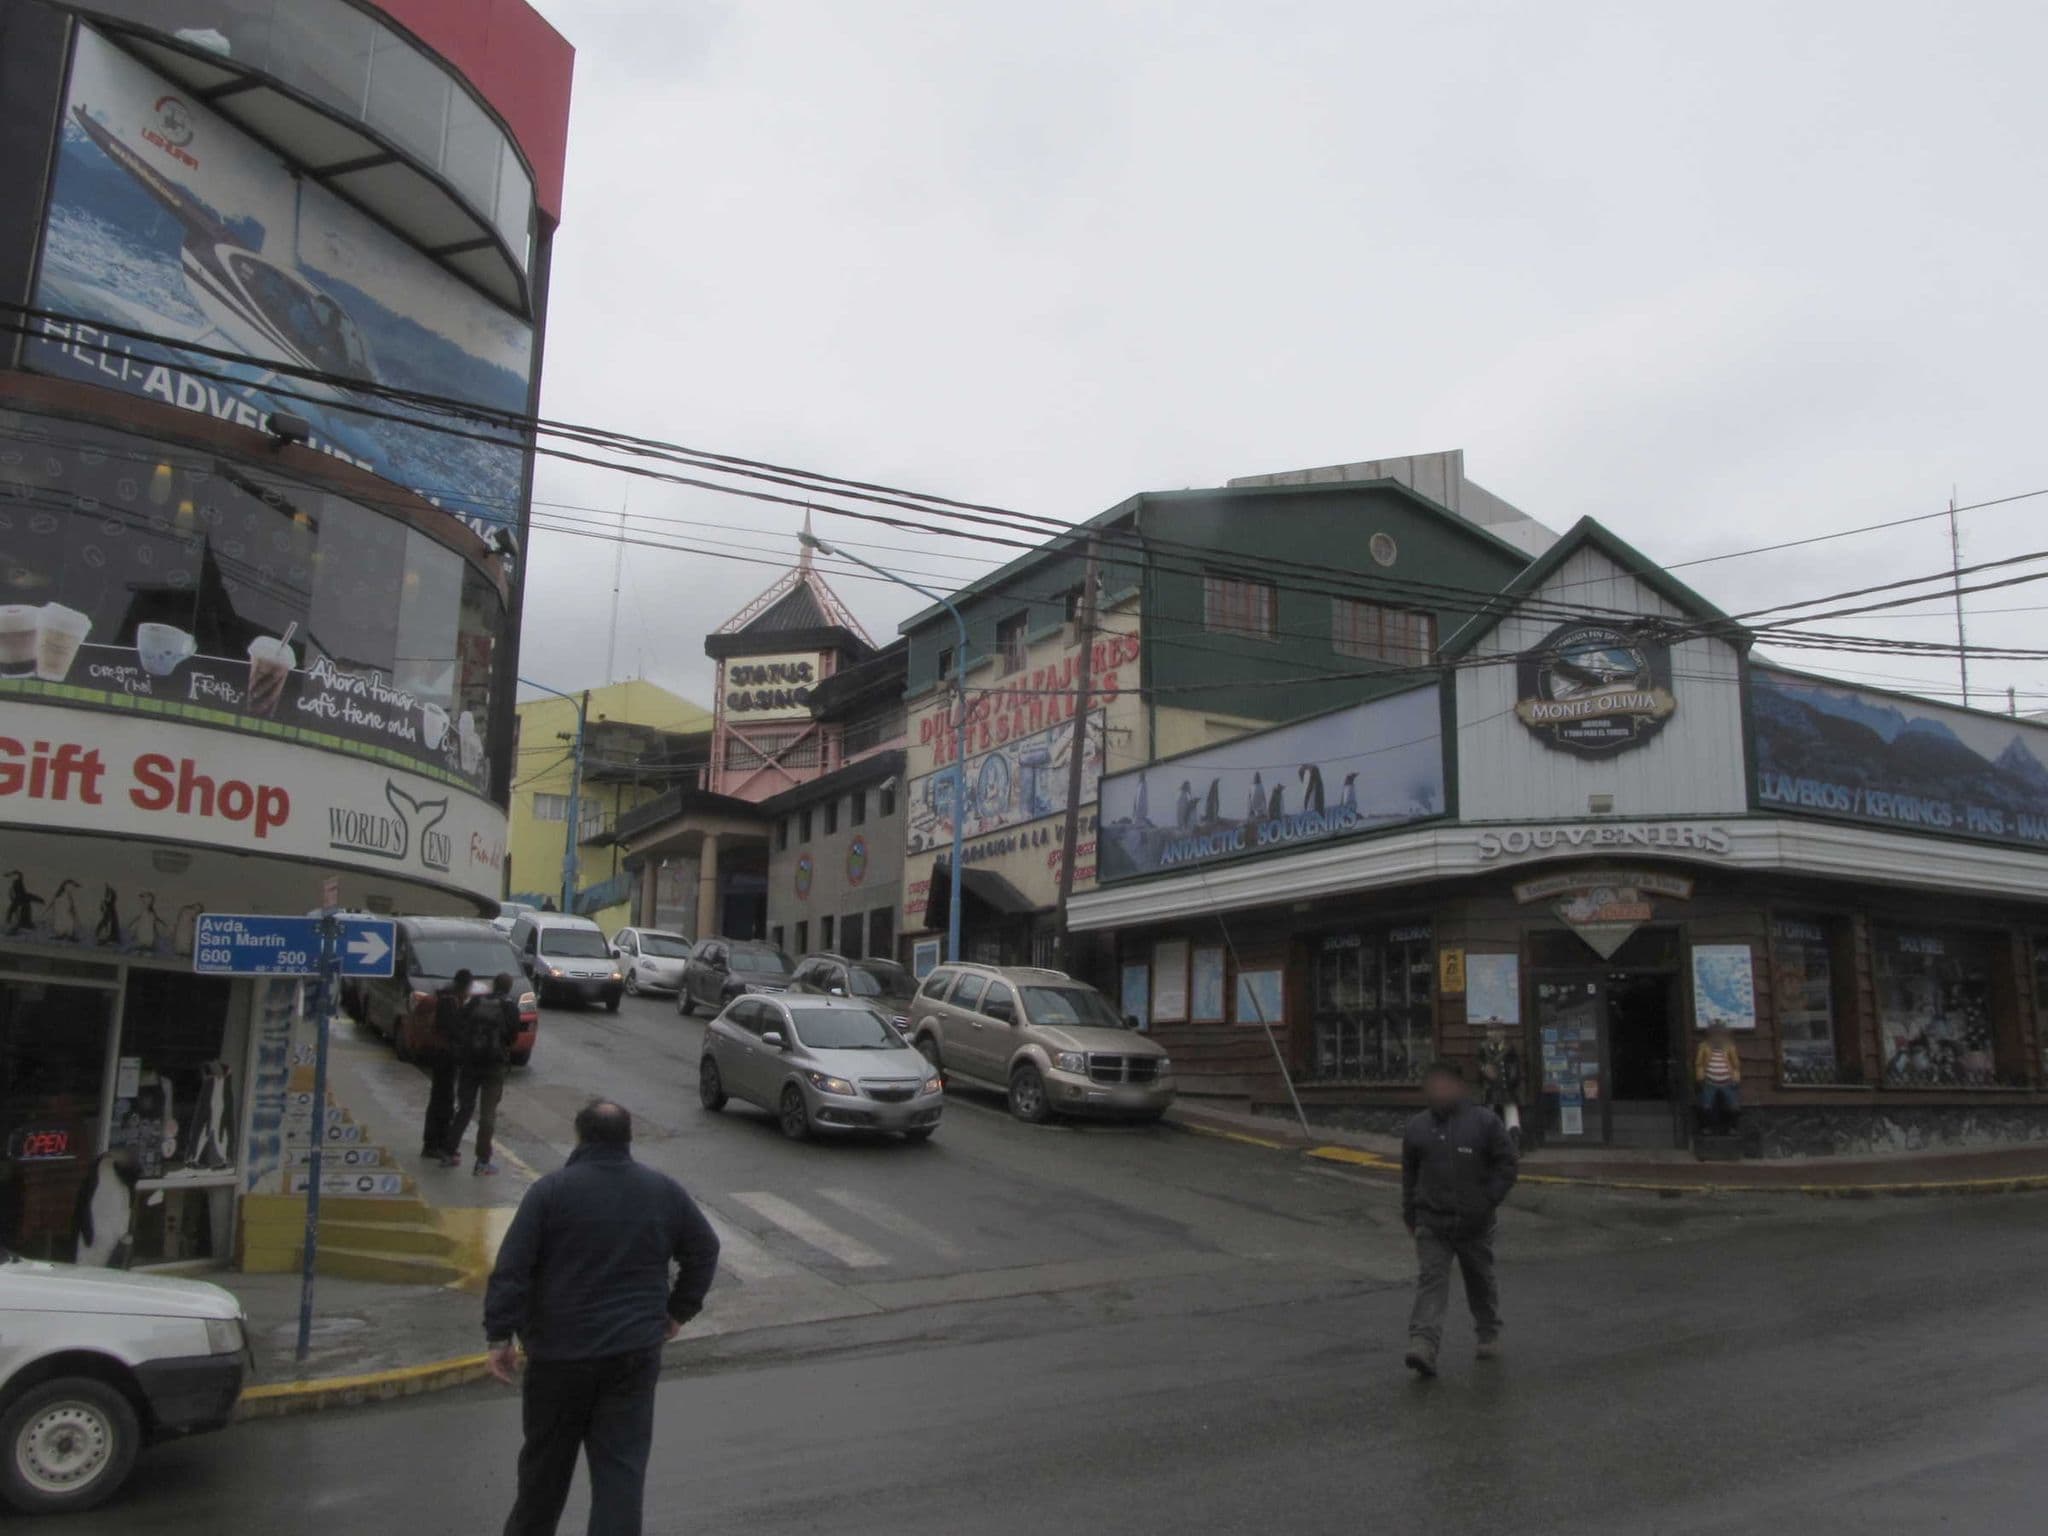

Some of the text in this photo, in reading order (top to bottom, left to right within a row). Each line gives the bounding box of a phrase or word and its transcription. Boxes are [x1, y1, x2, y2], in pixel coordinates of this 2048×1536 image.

[308, 657, 417, 711] Ahora tomar
[730, 662, 814, 687] STATUS
[342, 696, 386, 730] tiene
[727, 687, 812, 711] CASINO
[1531, 693, 1656, 719] MONTE OLIVIA
[128, 752, 291, 839] Shop
[1865, 789, 1952, 829] KEYRINGS
[1966, 806, 2004, 834] PINS
[428, 830, 451, 866] END
[1160, 804, 1358, 865] ANTARCTIC SOUVENIRS
[1479, 824, 1731, 859] SOUVENIRS
[199, 931, 286, 949] San Martín
[200, 917, 249, 933] Avda.
[199, 948, 308, 966] 600 500
[23, 1131, 69, 1156] OPEN
